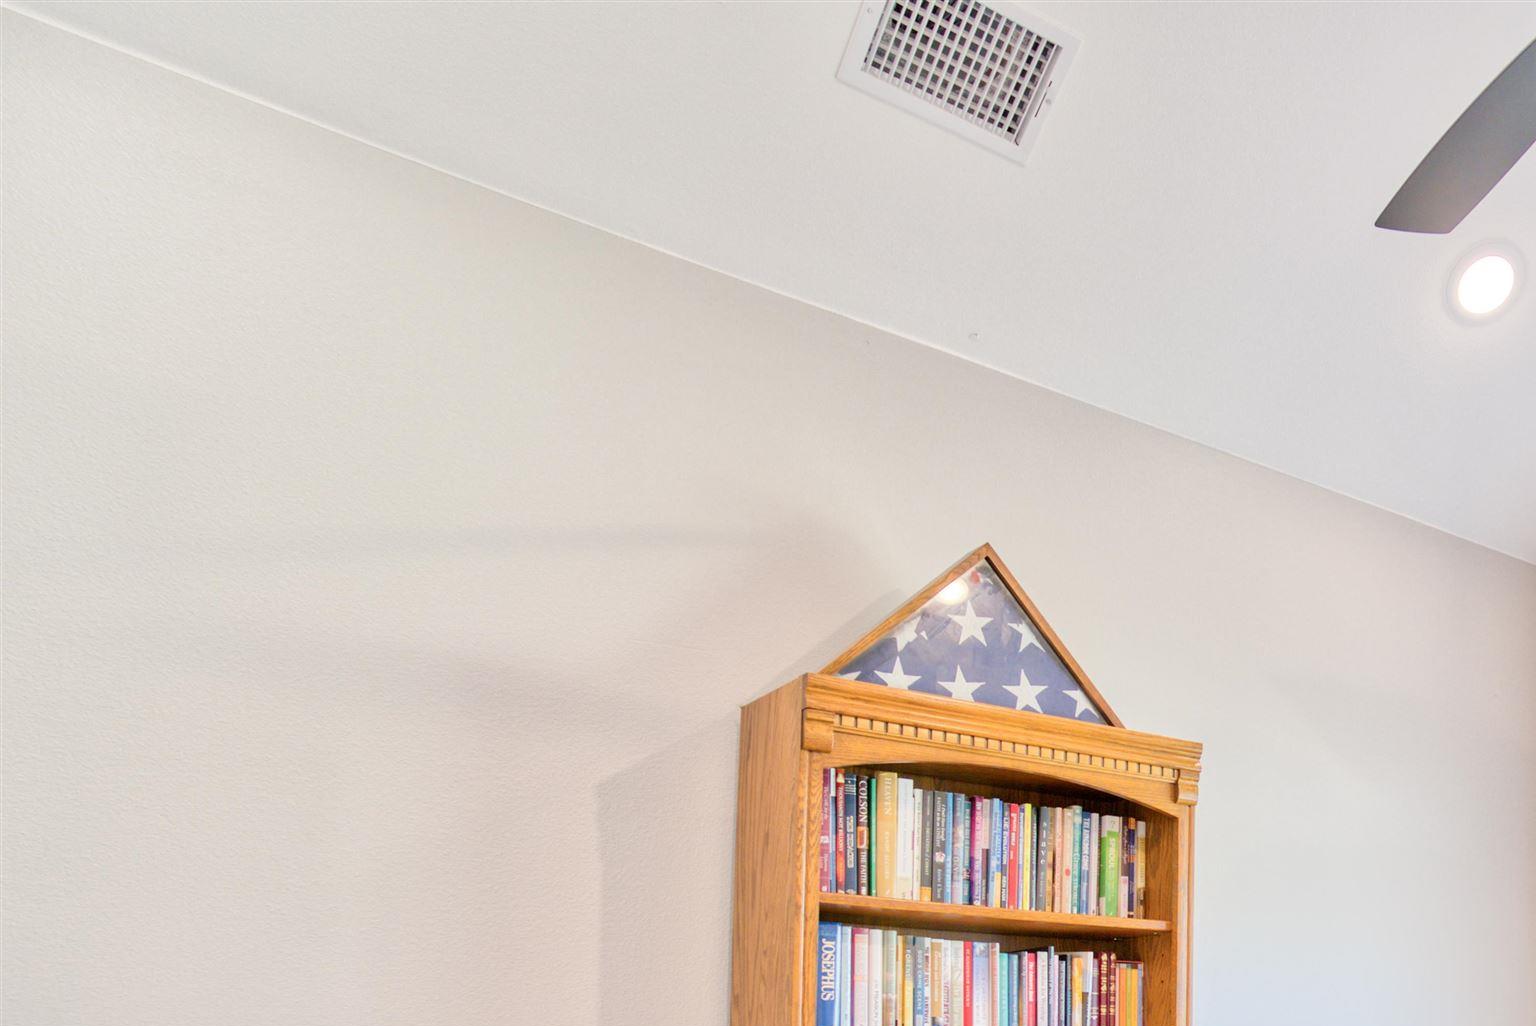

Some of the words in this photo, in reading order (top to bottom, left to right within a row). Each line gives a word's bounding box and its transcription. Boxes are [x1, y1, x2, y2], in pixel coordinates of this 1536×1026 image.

[859, 780, 869, 823] COLSON
[884, 777, 893, 816] HEAVEN
[821, 938, 836, 1001] JOSEPHUS
